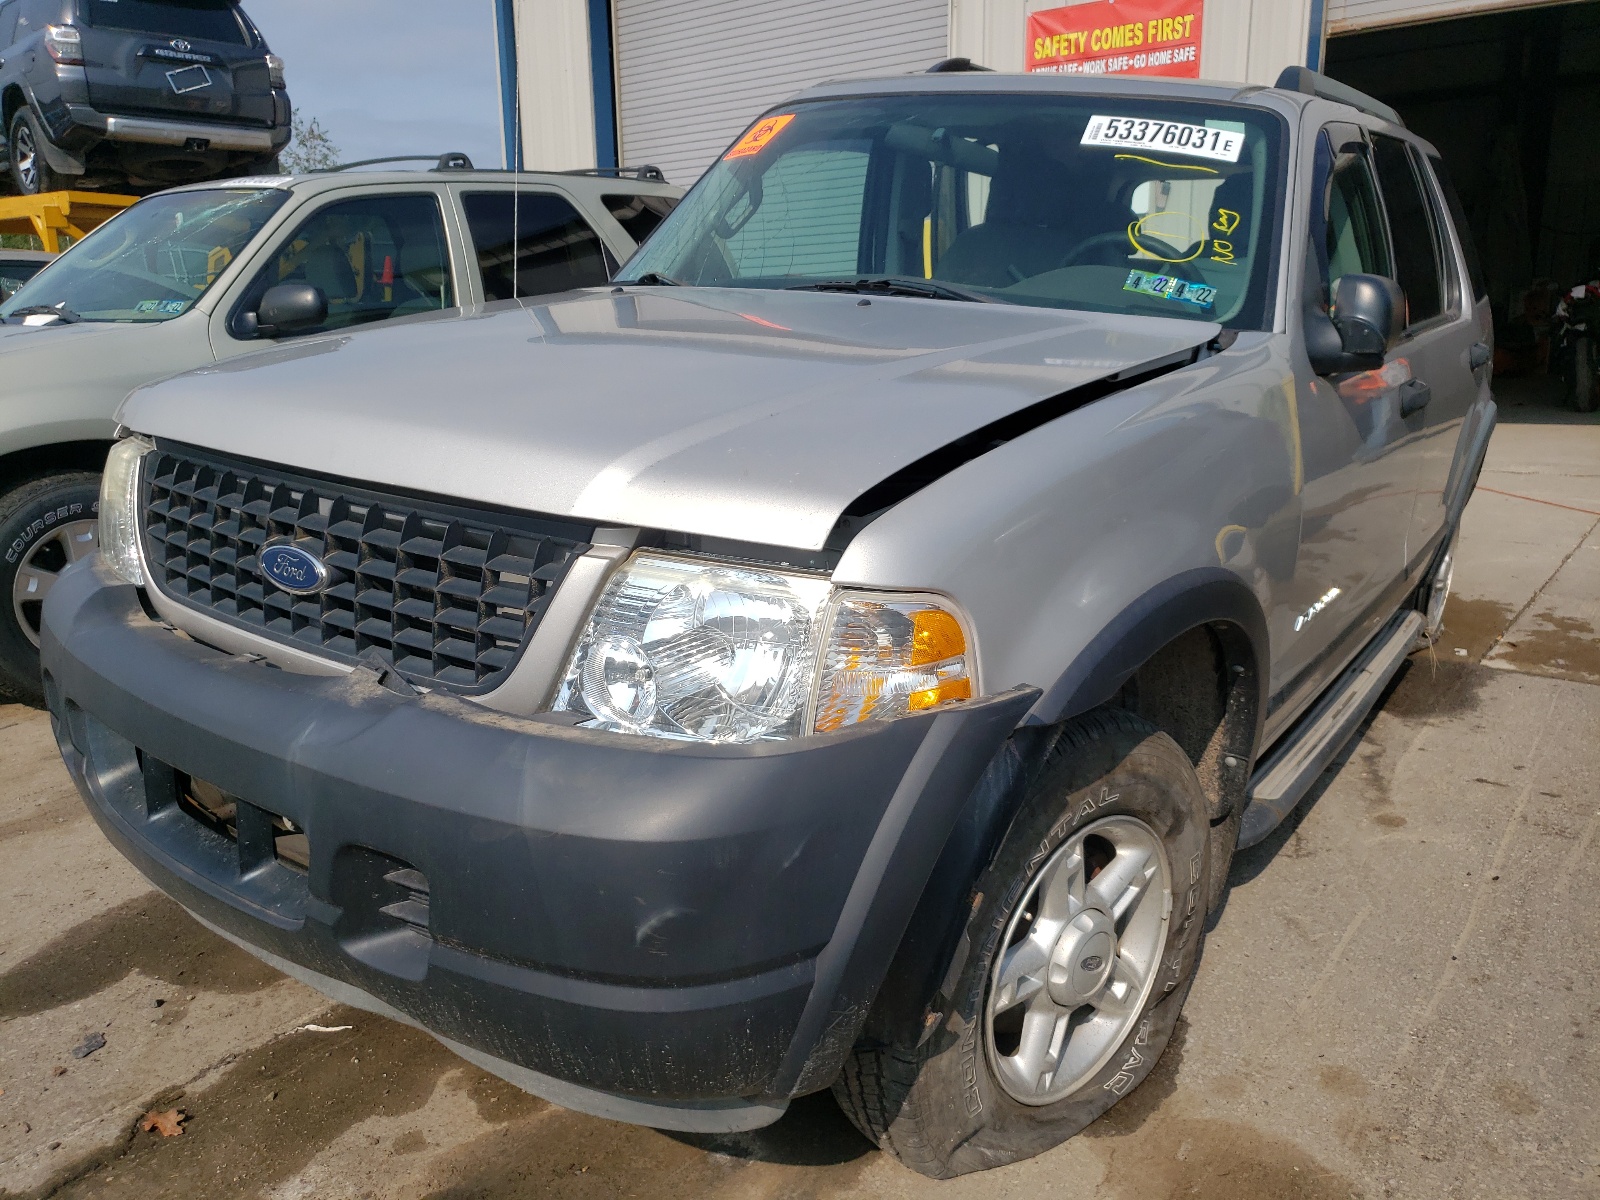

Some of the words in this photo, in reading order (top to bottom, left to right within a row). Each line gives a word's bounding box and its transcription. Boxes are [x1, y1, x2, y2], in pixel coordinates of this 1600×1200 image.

[1034, 28, 1088, 60] SAFETY
[1090, 22, 1143, 52] COMES
[1147, 14, 1195, 44] FIRST
[1148, 50, 1173, 67] HOME
[1173, 46, 1196, 62] SAFE
[1104, 118, 1221, 151] 53376031
[1223, 139, 1234, 152] E
[1131, 276, 1142, 289] 4
[1153, 276, 1169, 293] 22
[1174, 283, 1187, 298] 4
[1195, 287, 1212, 303] 22
[5, 502, 83, 564] COURSER
[273, 553, 306, 581] Ford
